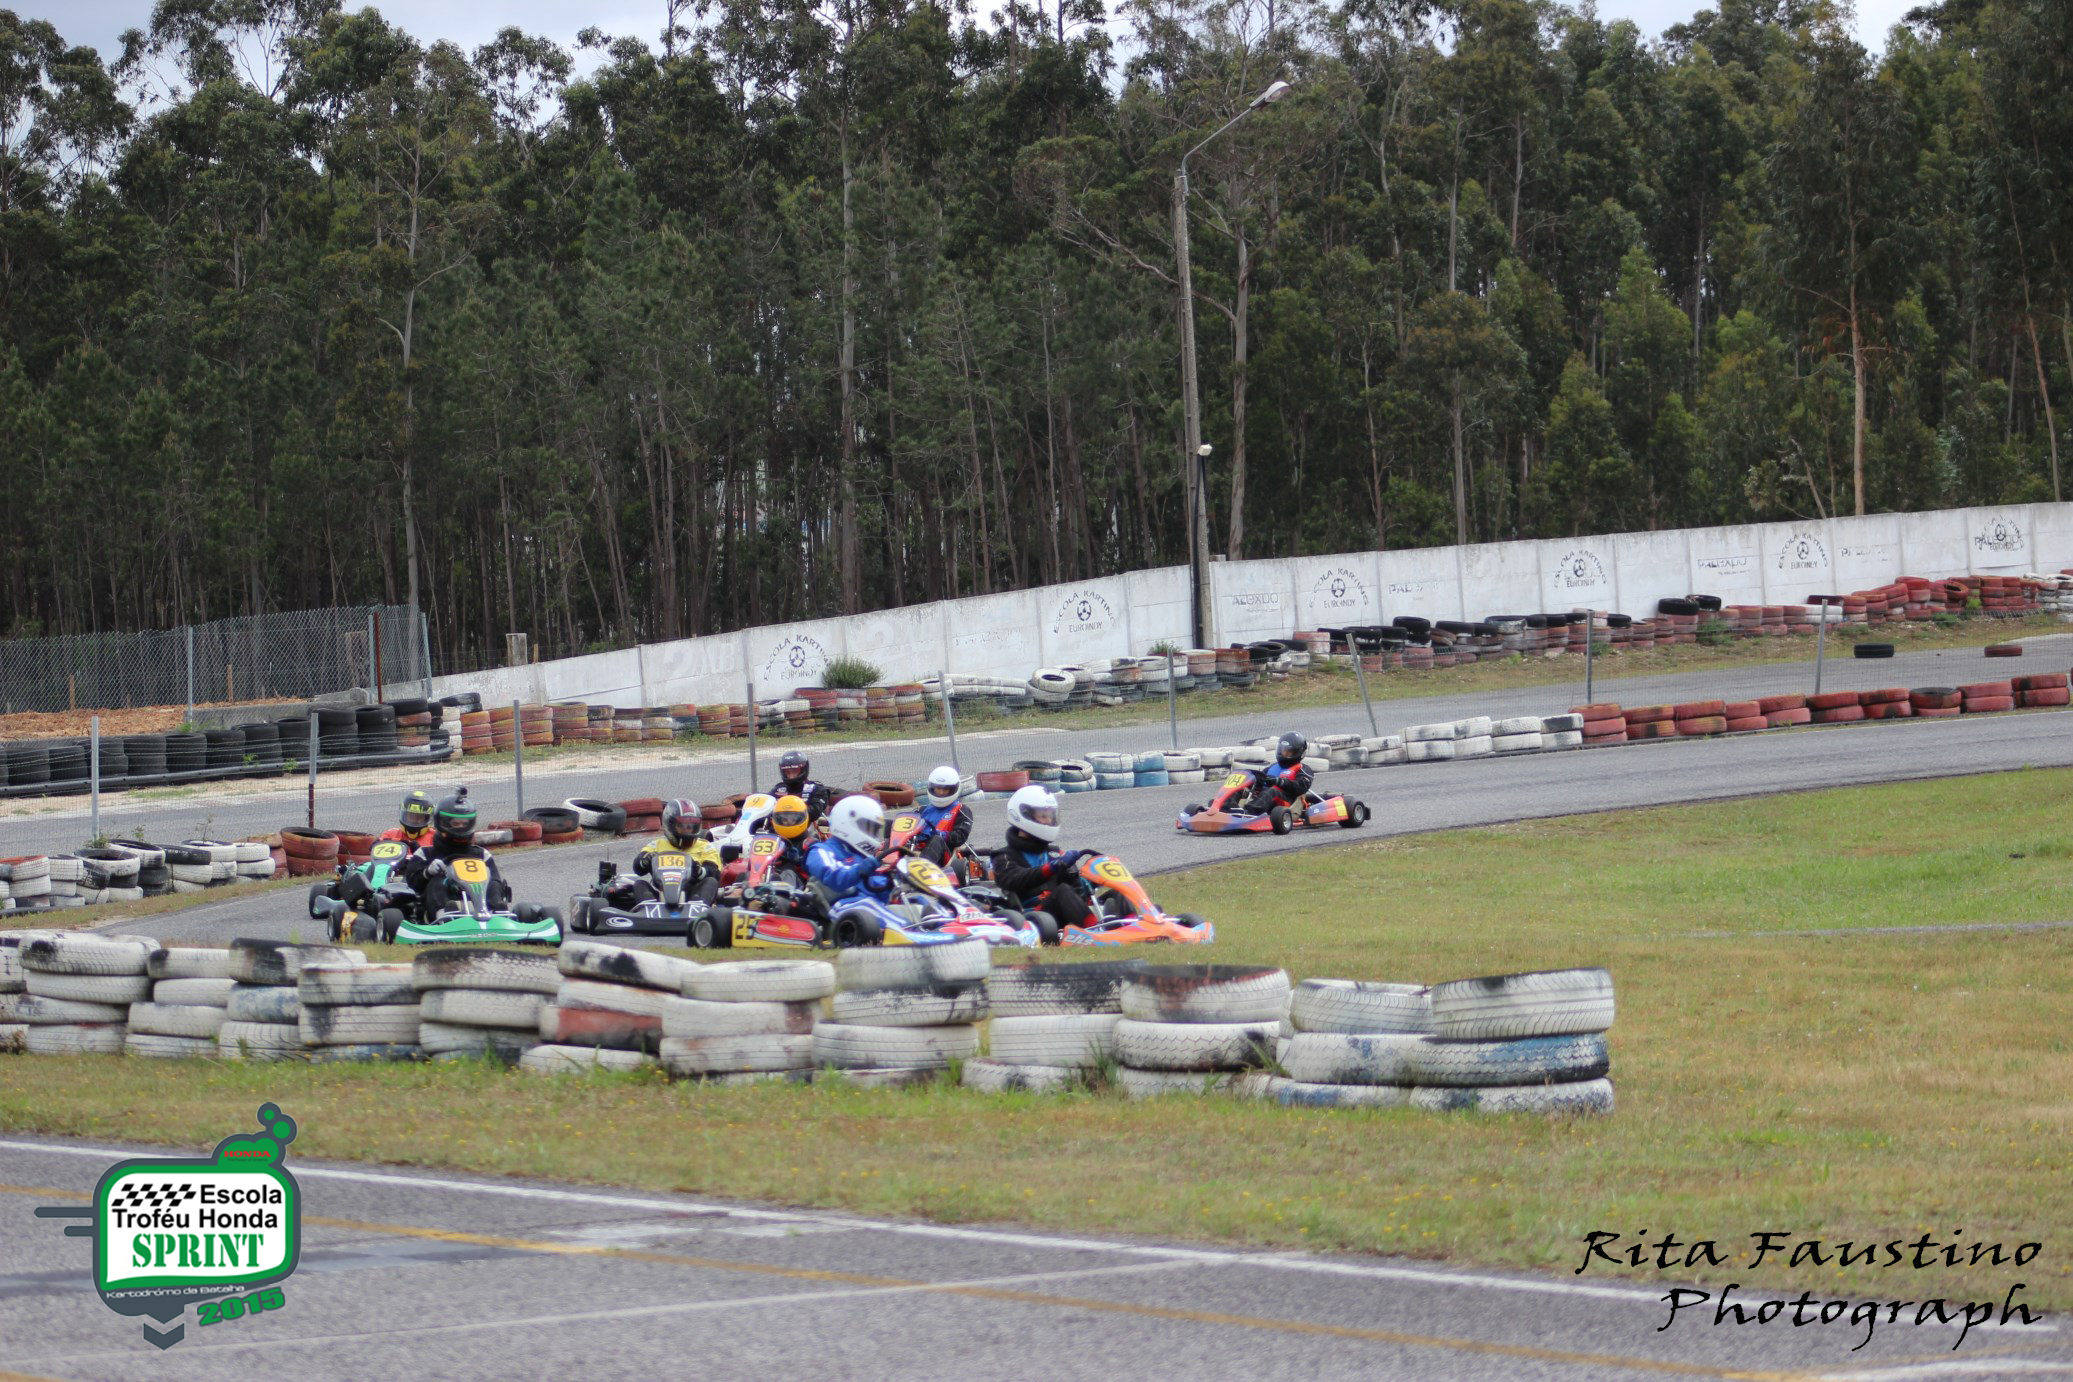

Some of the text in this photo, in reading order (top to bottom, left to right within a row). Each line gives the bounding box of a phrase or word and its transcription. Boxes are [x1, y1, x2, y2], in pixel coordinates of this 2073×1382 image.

[903, 818, 914, 829] 3
[376, 846, 396, 855] 74
[753, 840, 774, 853] 63
[464, 860, 478, 873] 8
[660, 855, 684, 867] 136
